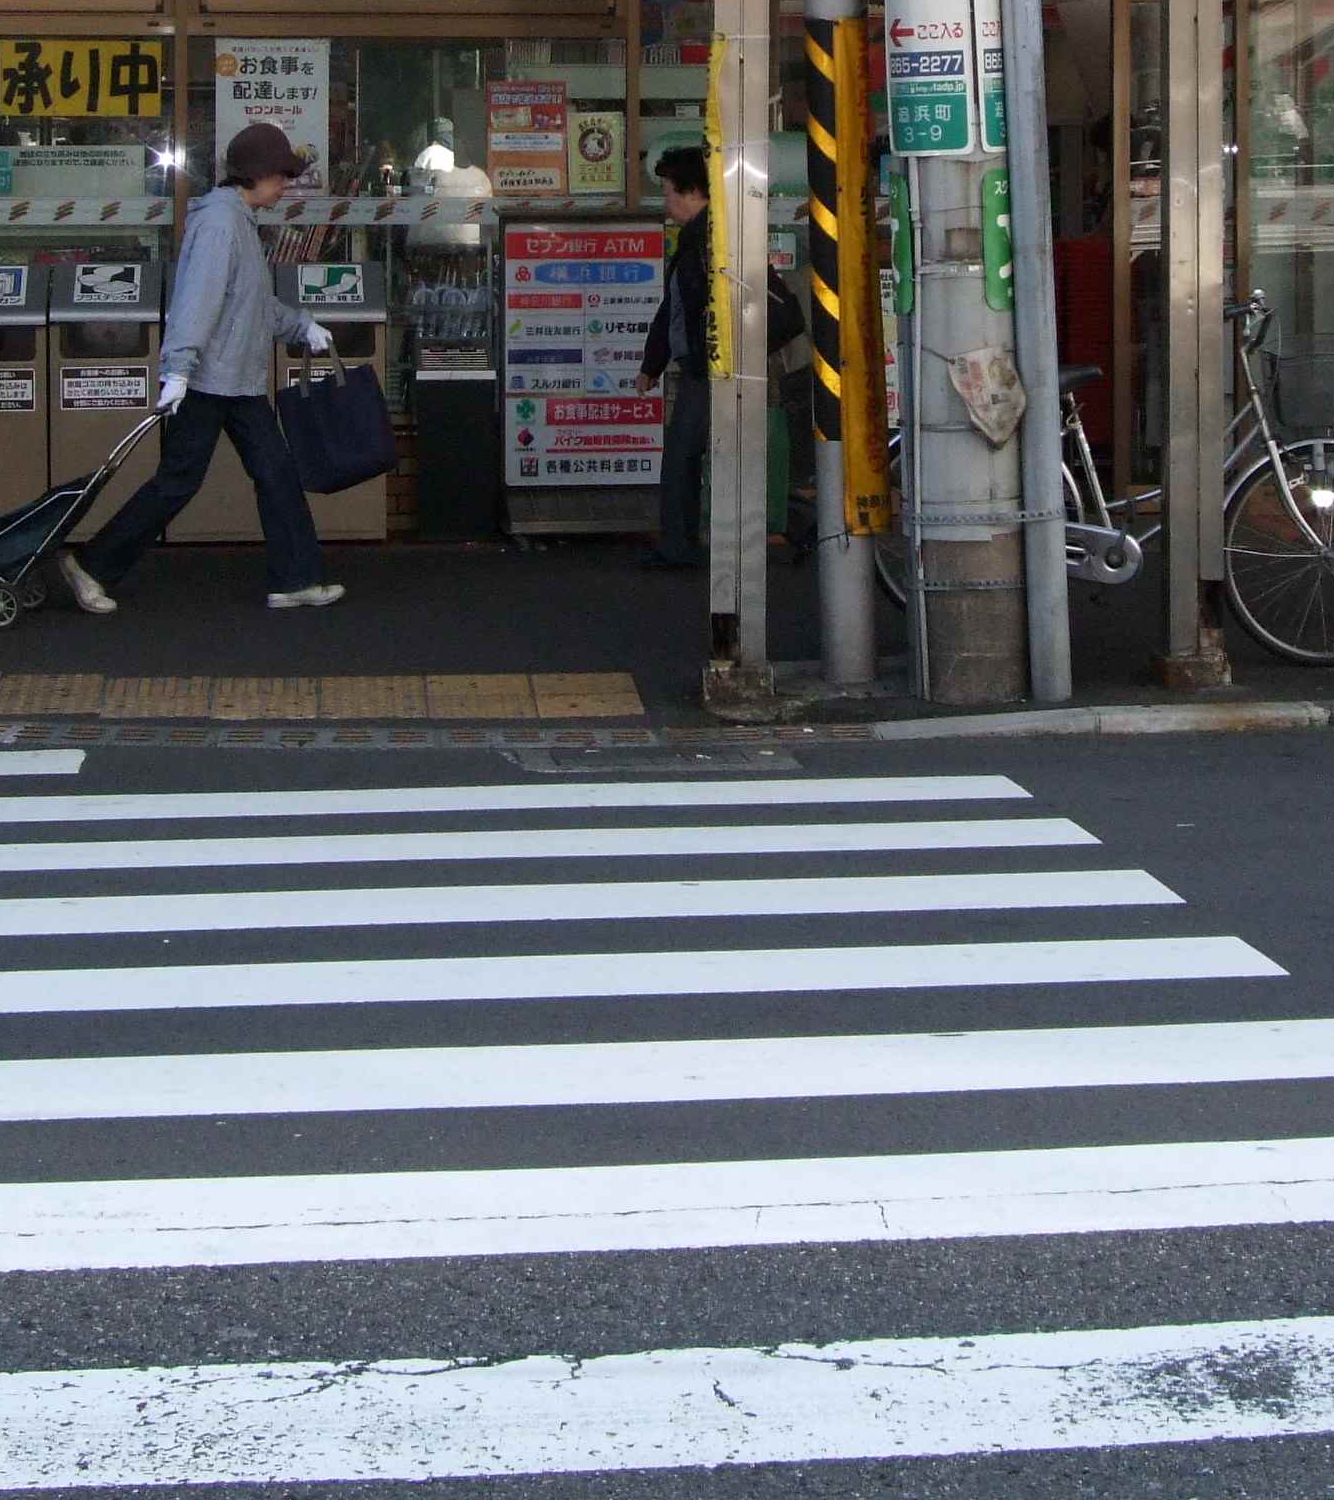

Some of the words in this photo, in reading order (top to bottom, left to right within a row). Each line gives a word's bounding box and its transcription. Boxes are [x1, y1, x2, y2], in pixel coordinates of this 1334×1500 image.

[916, 20, 964, 40] ここ入る
[239, 55, 315, 76] お食事を
[232, 80, 318, 101] 配達します!
[904, 124, 943, 143] 3-9
[525, 237, 597, 253] セブン銀行
[604, 237, 645, 254] ATM
[603, 322, 652, 335] りそな銀
[553, 402, 656, 419] お食事配達サービス
[545, 459, 652, 474] 各種公共料金窓口
